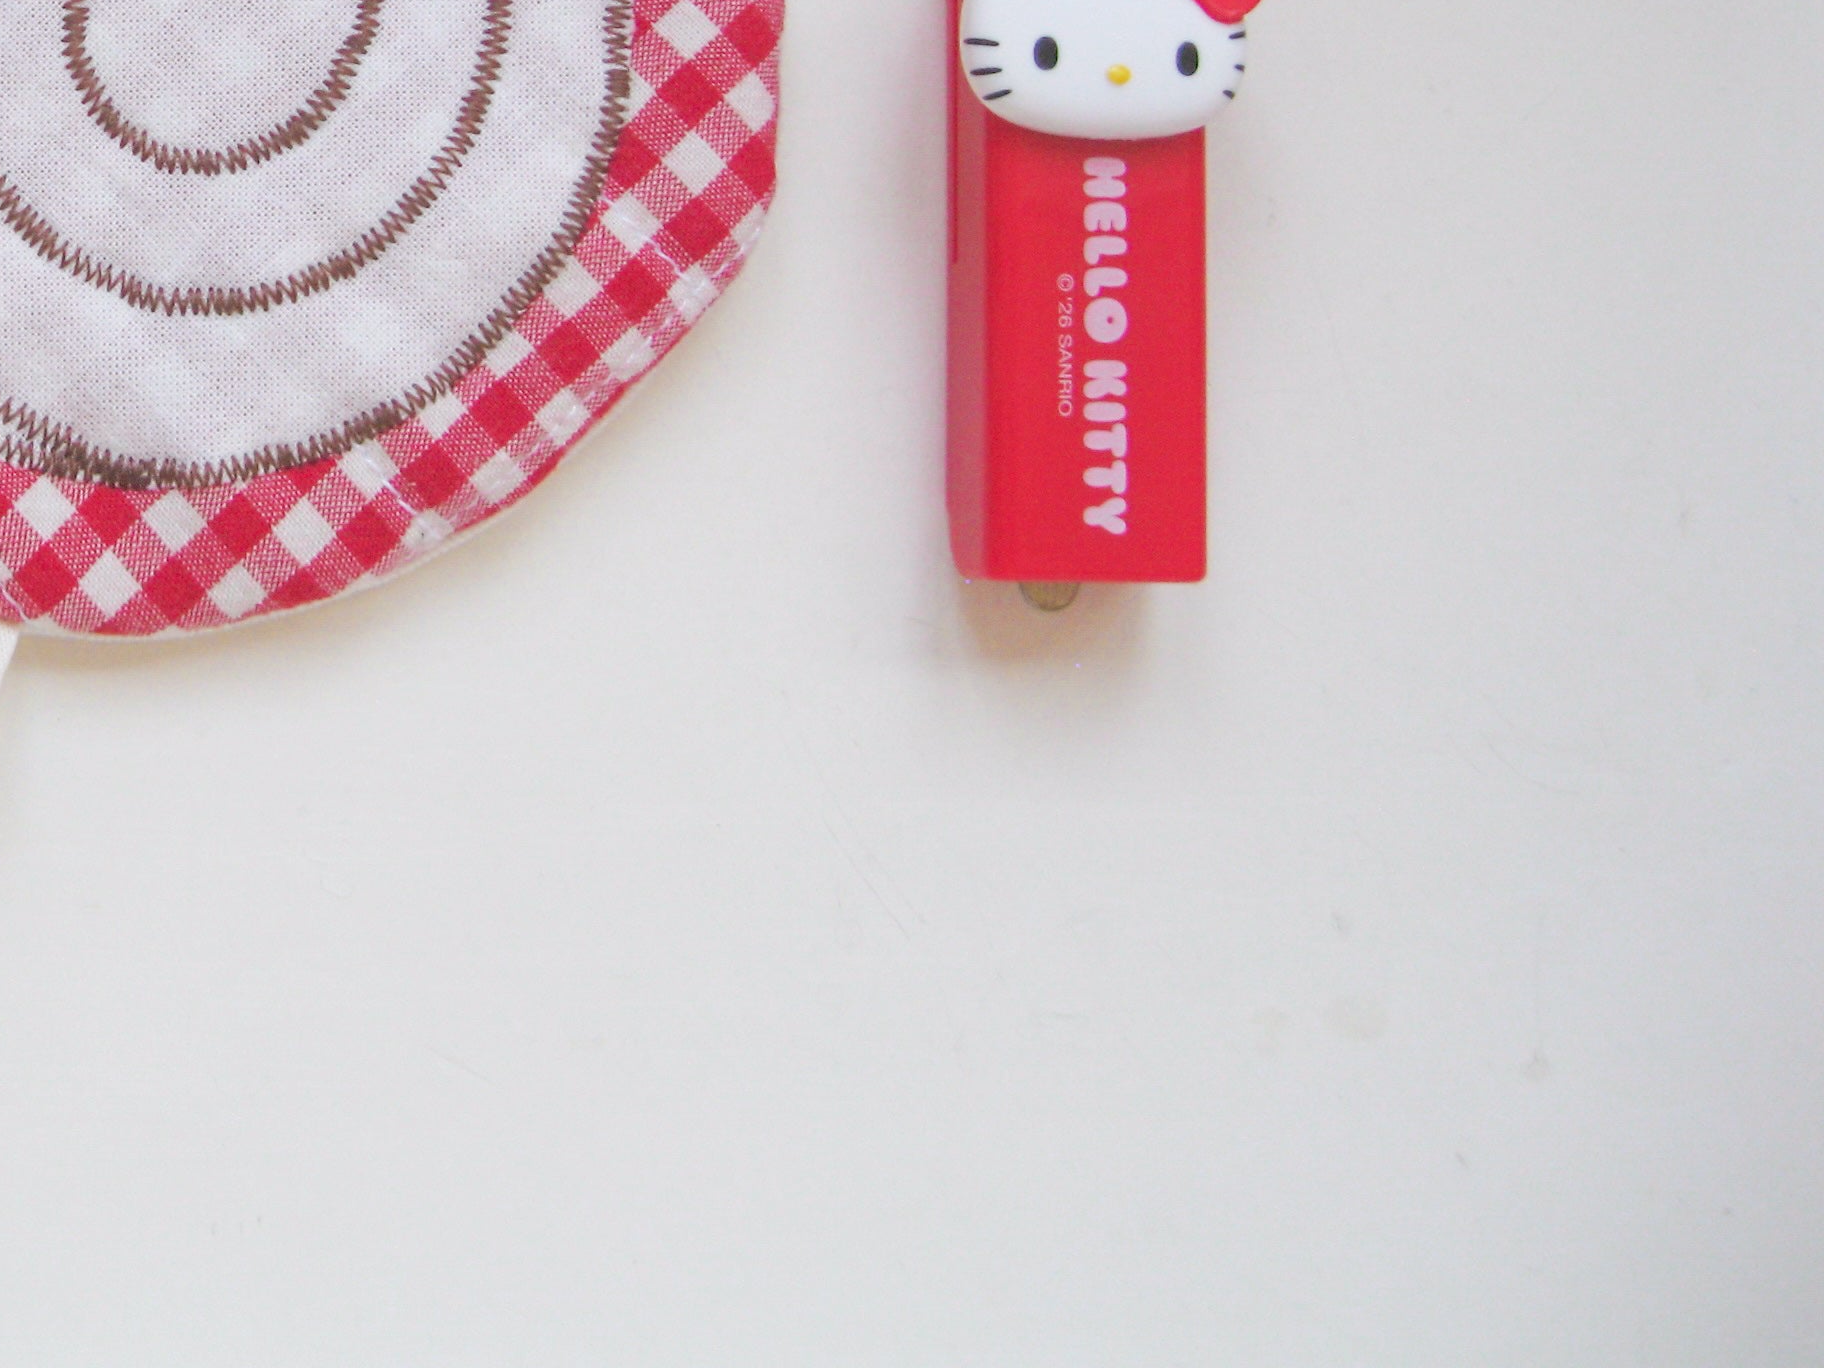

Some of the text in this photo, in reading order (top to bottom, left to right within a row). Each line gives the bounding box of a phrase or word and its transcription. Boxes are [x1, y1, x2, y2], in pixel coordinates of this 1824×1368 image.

[1057, 334, 1074, 417] SANRIO
[1082, 156, 1128, 535] HELLO KITTY
